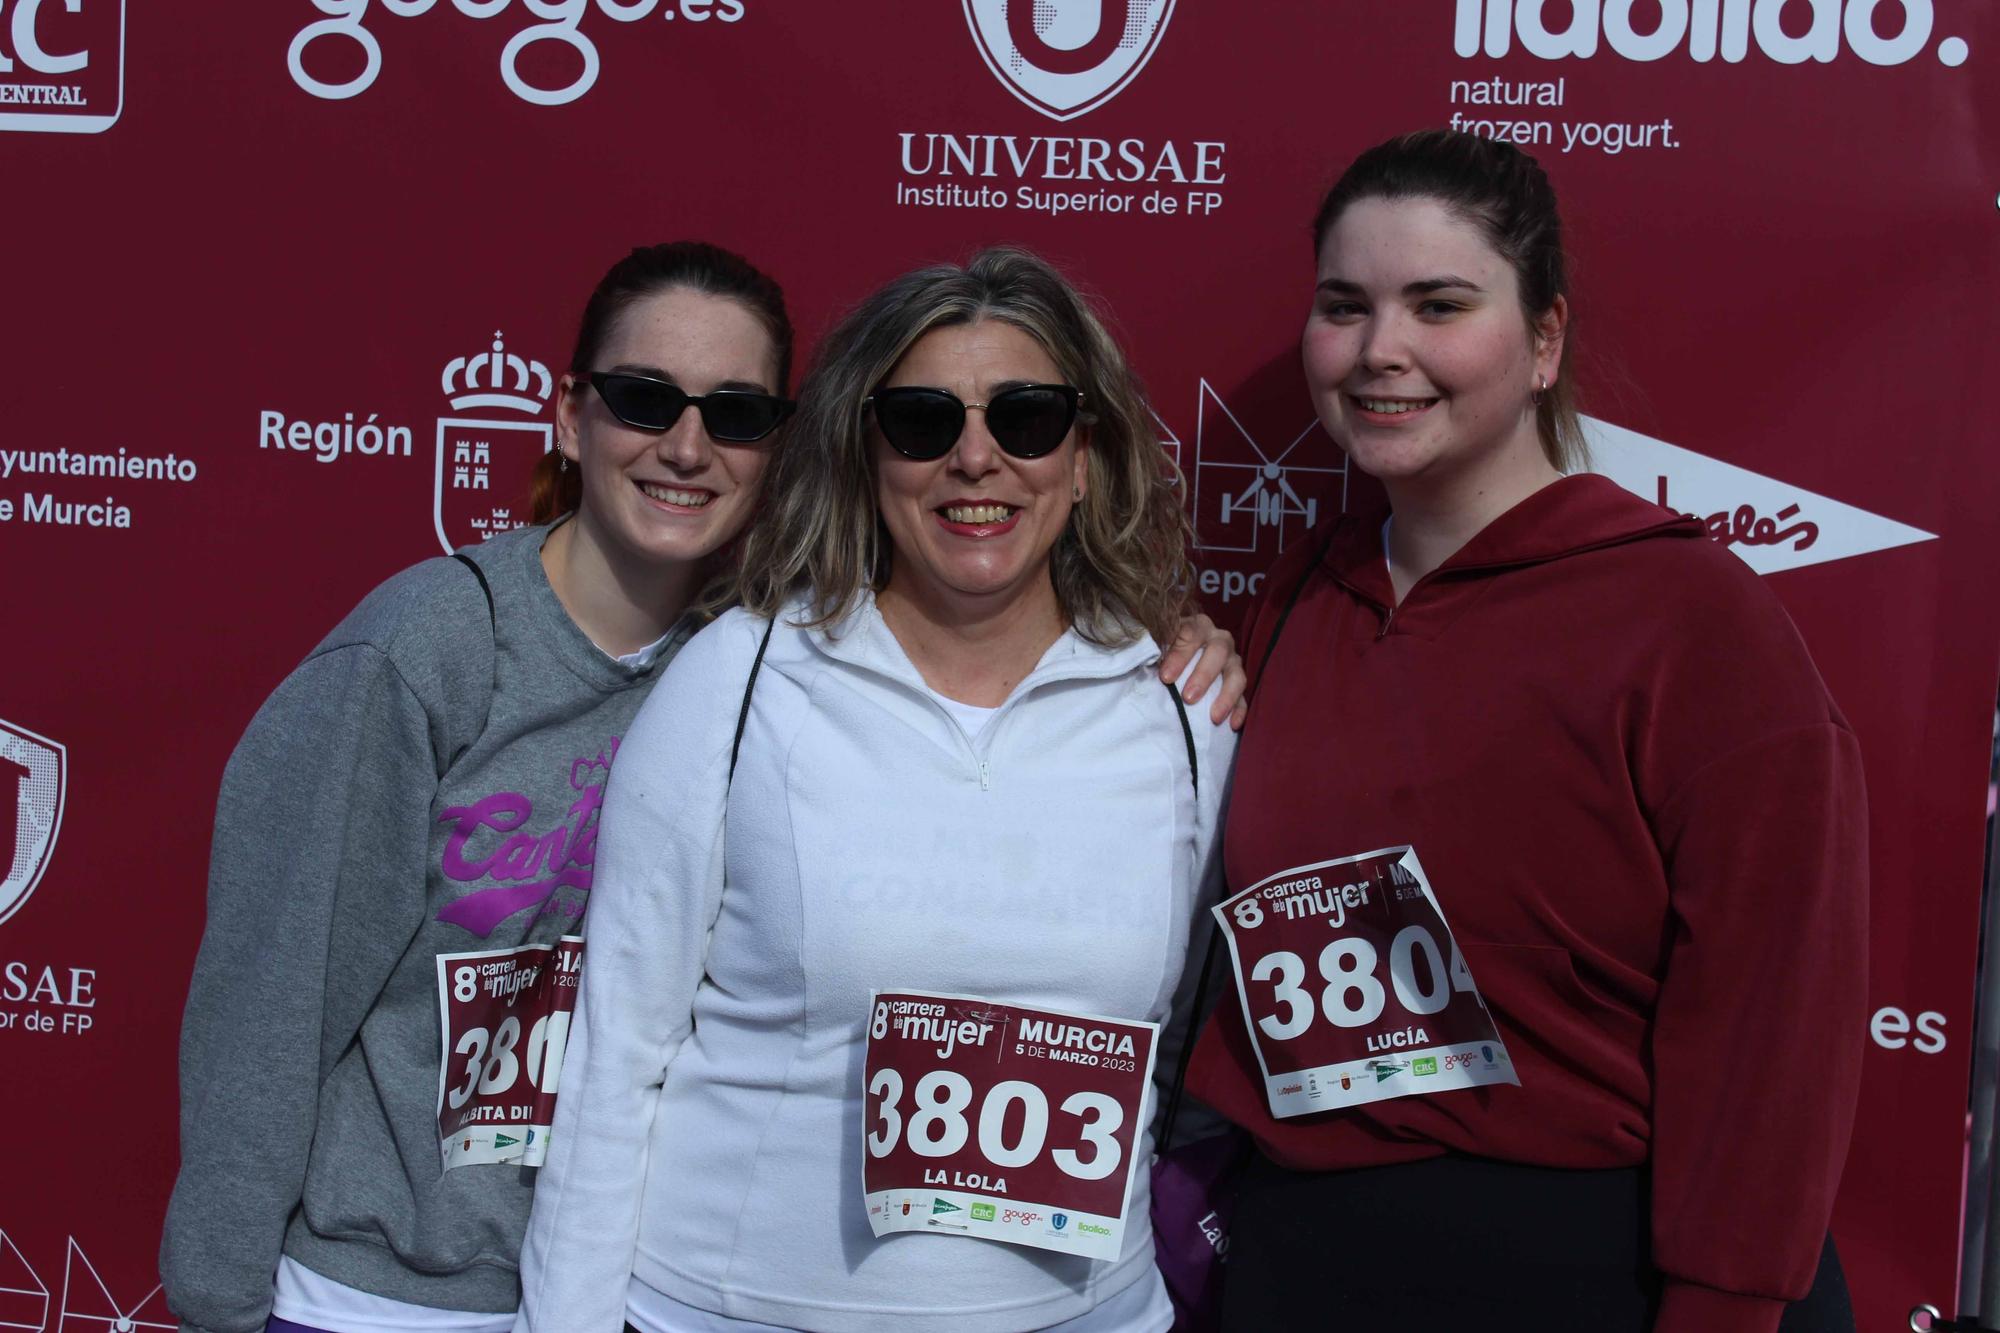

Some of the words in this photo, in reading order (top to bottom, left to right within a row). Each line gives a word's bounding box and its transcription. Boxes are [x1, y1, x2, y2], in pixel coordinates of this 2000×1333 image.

[0, 0, 88, 73] C
[1450, 76, 1565, 106] natural
[1449, 112, 1552, 144] frozen
[1562, 119, 1680, 154] yogurt.
[898, 133, 1226, 184] UNIVERSAE
[897, 182, 1008, 208] Instituto
[1015, 186, 1134, 216] Superior
[1142, 190, 1178, 214] de
[1187, 192, 1223, 215] FP
[259, 410, 413, 463] Región
[0, 447, 197, 482] yuntamiento
[23, 492, 131, 528] Murcia
[1263, 876, 1323, 899] carrera
[1285, 881, 1370, 928] mujer
[0, 962, 96, 1008] SAE
[482, 959, 516, 976] carrera
[492, 967, 540, 1007] mujer
[24, 1010, 55, 1032] de
[62, 1013, 93, 1035] FP
[892, 1000, 946, 1017] carrera
[902, 1016, 993, 1059] mujer
[1019, 1018, 1136, 1057] MURCIA
[1366, 1027, 1430, 1052] LUCÍA
[1870, 1006, 1946, 1054] es
[1016, 1043, 1025, 1055] 5
[1028, 1045, 1046, 1058] DE
[1049, 1048, 1099, 1066] MARZO
[1101, 1056, 1136, 1072] 2023
[459, 1106, 506, 1125] ALBITA
[511, 1106, 532, 1120] DI
[868, 1068, 1124, 1180] 3803
[924, 1168, 948, 1184] LA
[954, 1171, 1008, 1192] LOLA
